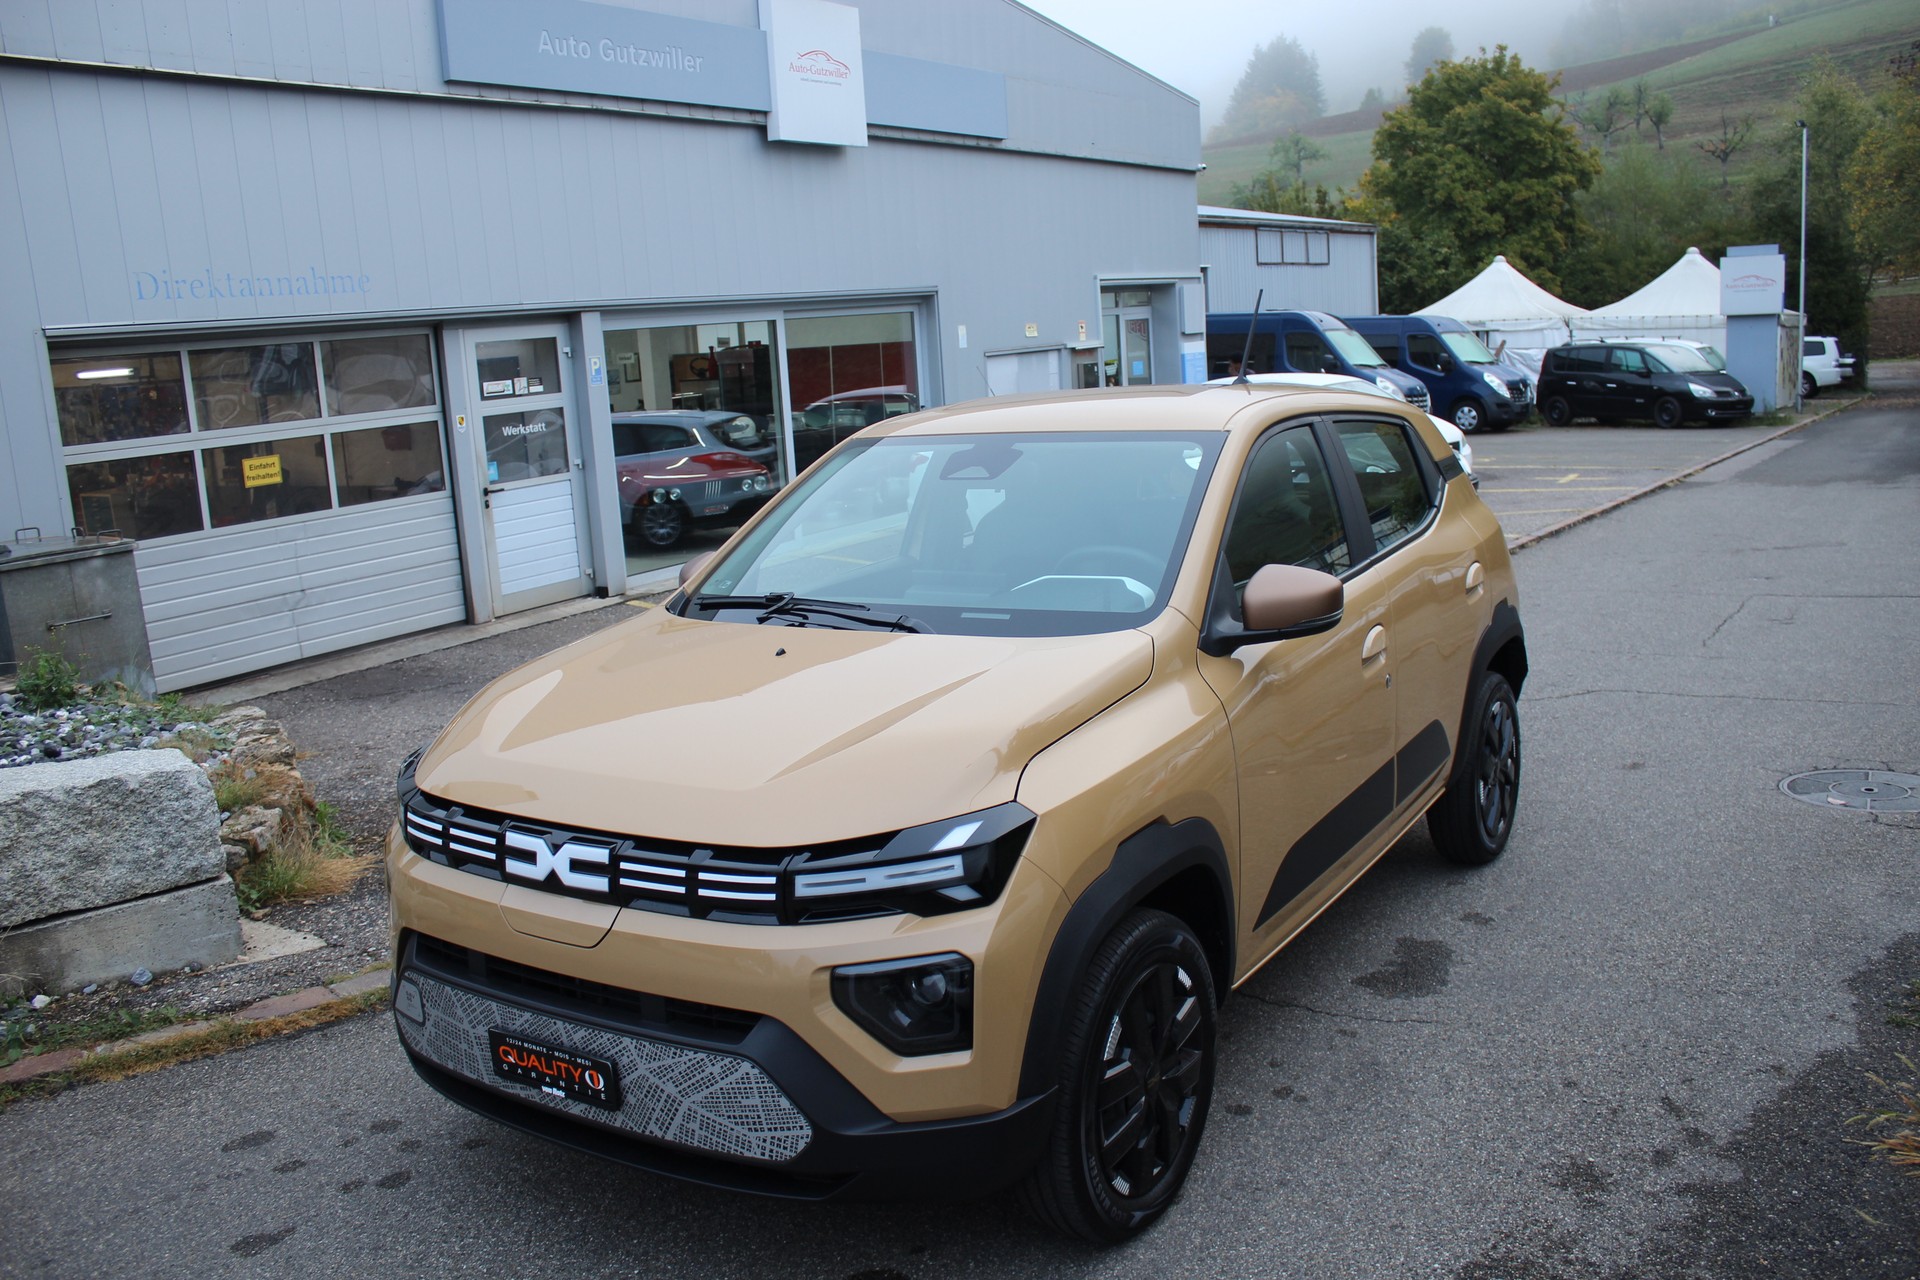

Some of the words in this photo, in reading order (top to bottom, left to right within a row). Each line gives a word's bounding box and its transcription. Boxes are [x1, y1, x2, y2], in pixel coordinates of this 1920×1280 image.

[538, 29, 591, 59] Auto
[599, 38, 703, 73] Gutzwiller
[789, 62, 848, 79] Auto-Gutzwiller
[132, 266, 371, 300] Direktannahme
[590, 358, 600, 376] P
[502, 422, 547, 436] Werkstatt
[246, 470, 280, 481] freihalten!
[248, 461, 276, 471] Einfahrt
[498, 1045, 582, 1083] QUALITY
[523, 1042, 547, 1054] MONATE
[554, 1051, 570, 1060] MOIS
[576, 1057, 592, 1067] MESI
[502, 1063, 606, 1100] GARANTIE
